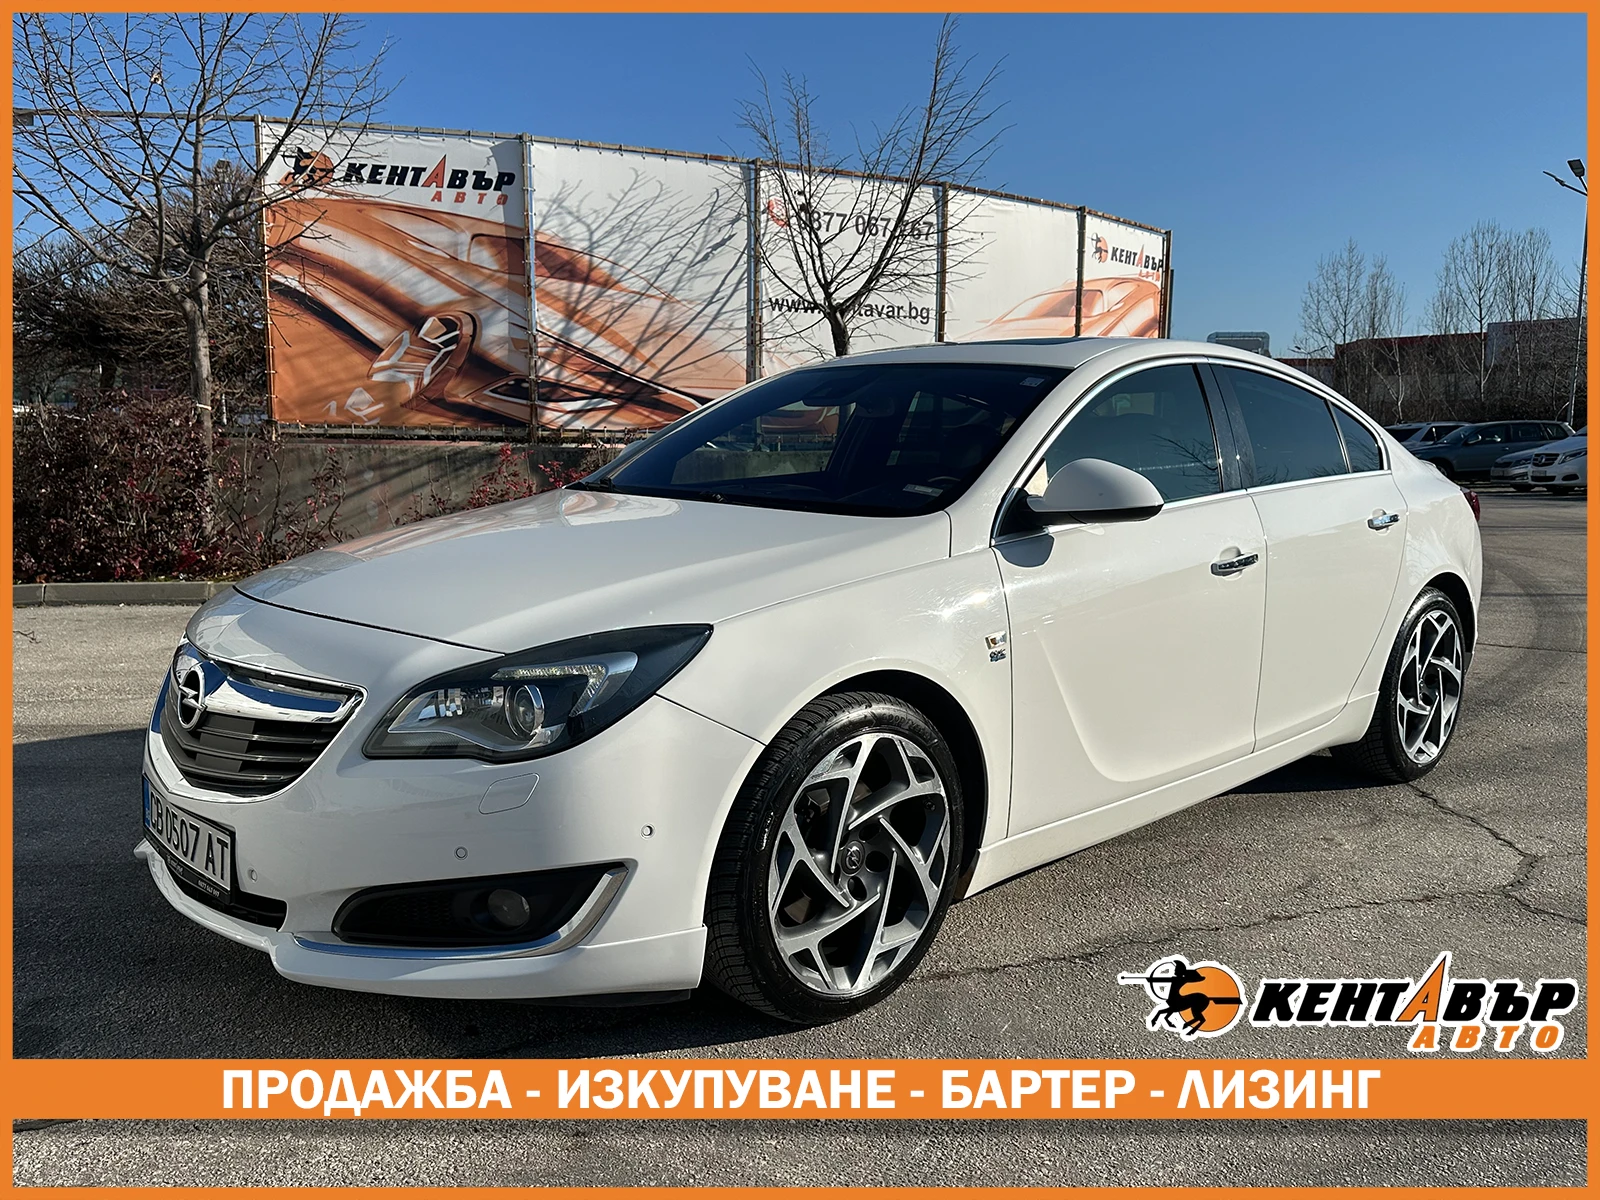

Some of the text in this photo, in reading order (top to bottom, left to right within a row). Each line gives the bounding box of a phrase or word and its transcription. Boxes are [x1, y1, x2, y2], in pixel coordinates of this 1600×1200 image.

[342, 154, 516, 192] КЕНТАВЪР
[430, 190, 509, 206] АВТО
[769, 297, 930, 324] www.tavar.bg
[166, 804, 201, 863] 0507
